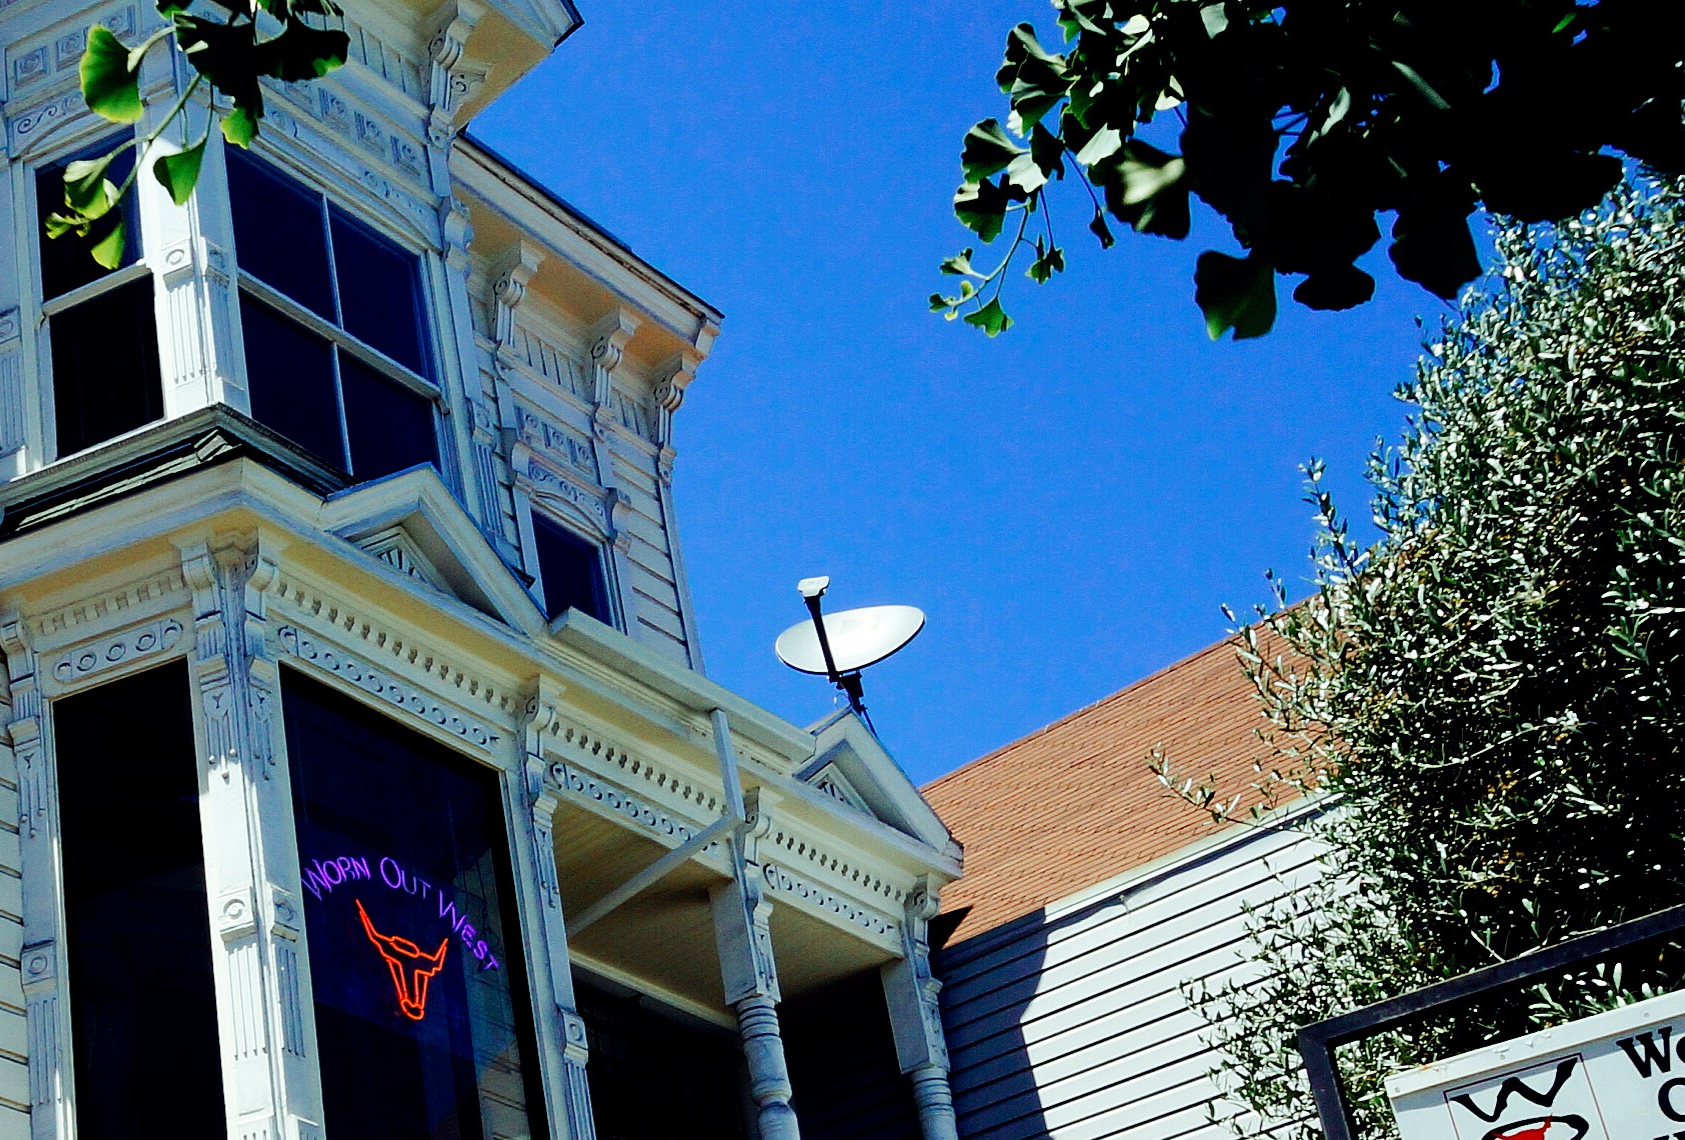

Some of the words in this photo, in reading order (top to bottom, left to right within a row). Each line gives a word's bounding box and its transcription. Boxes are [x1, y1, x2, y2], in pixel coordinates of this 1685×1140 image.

[302, 856, 371, 901] WORN
[380, 857, 431, 899] OUT
[439, 890, 500, 972] WEST
[1616, 1026, 1685, 1078] W
